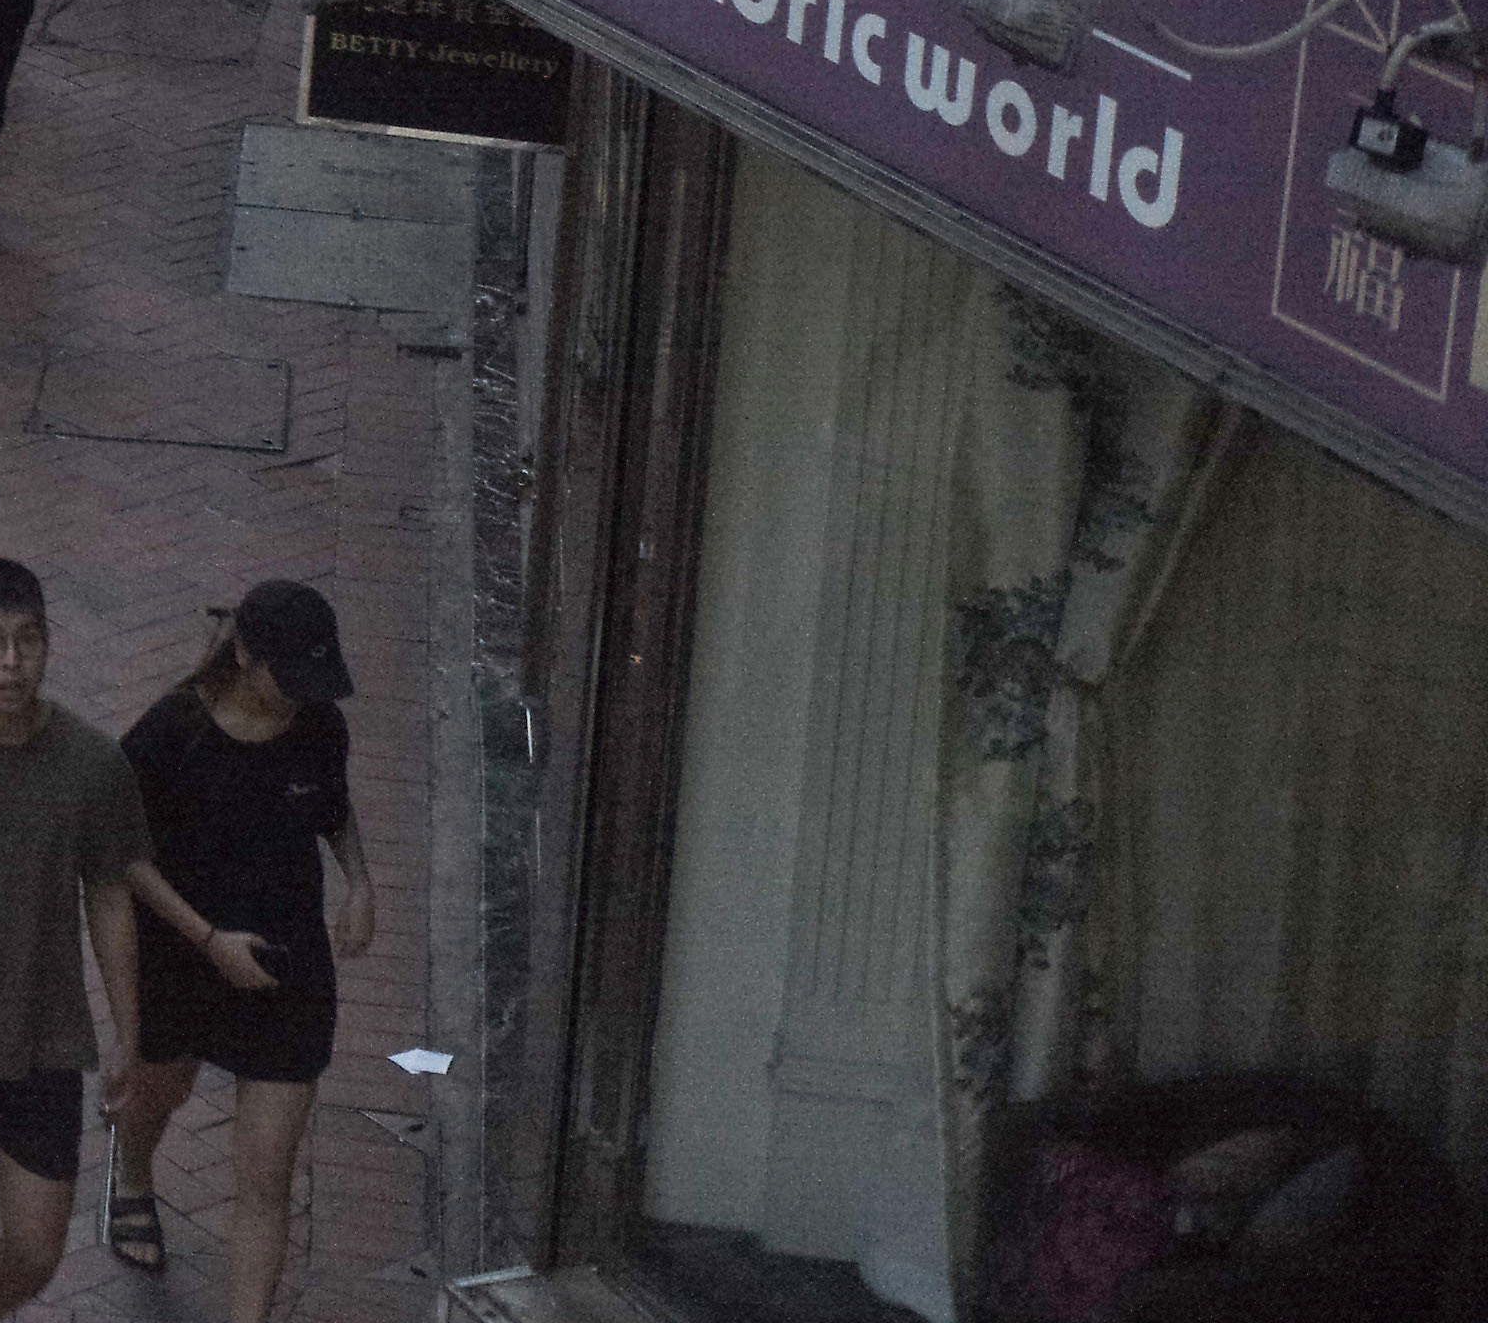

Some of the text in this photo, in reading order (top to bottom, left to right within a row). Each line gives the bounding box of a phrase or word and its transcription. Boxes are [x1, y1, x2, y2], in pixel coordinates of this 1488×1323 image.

[329, 30, 560, 78] BETTY Jewellery
[905, 30, 1184, 228] world
